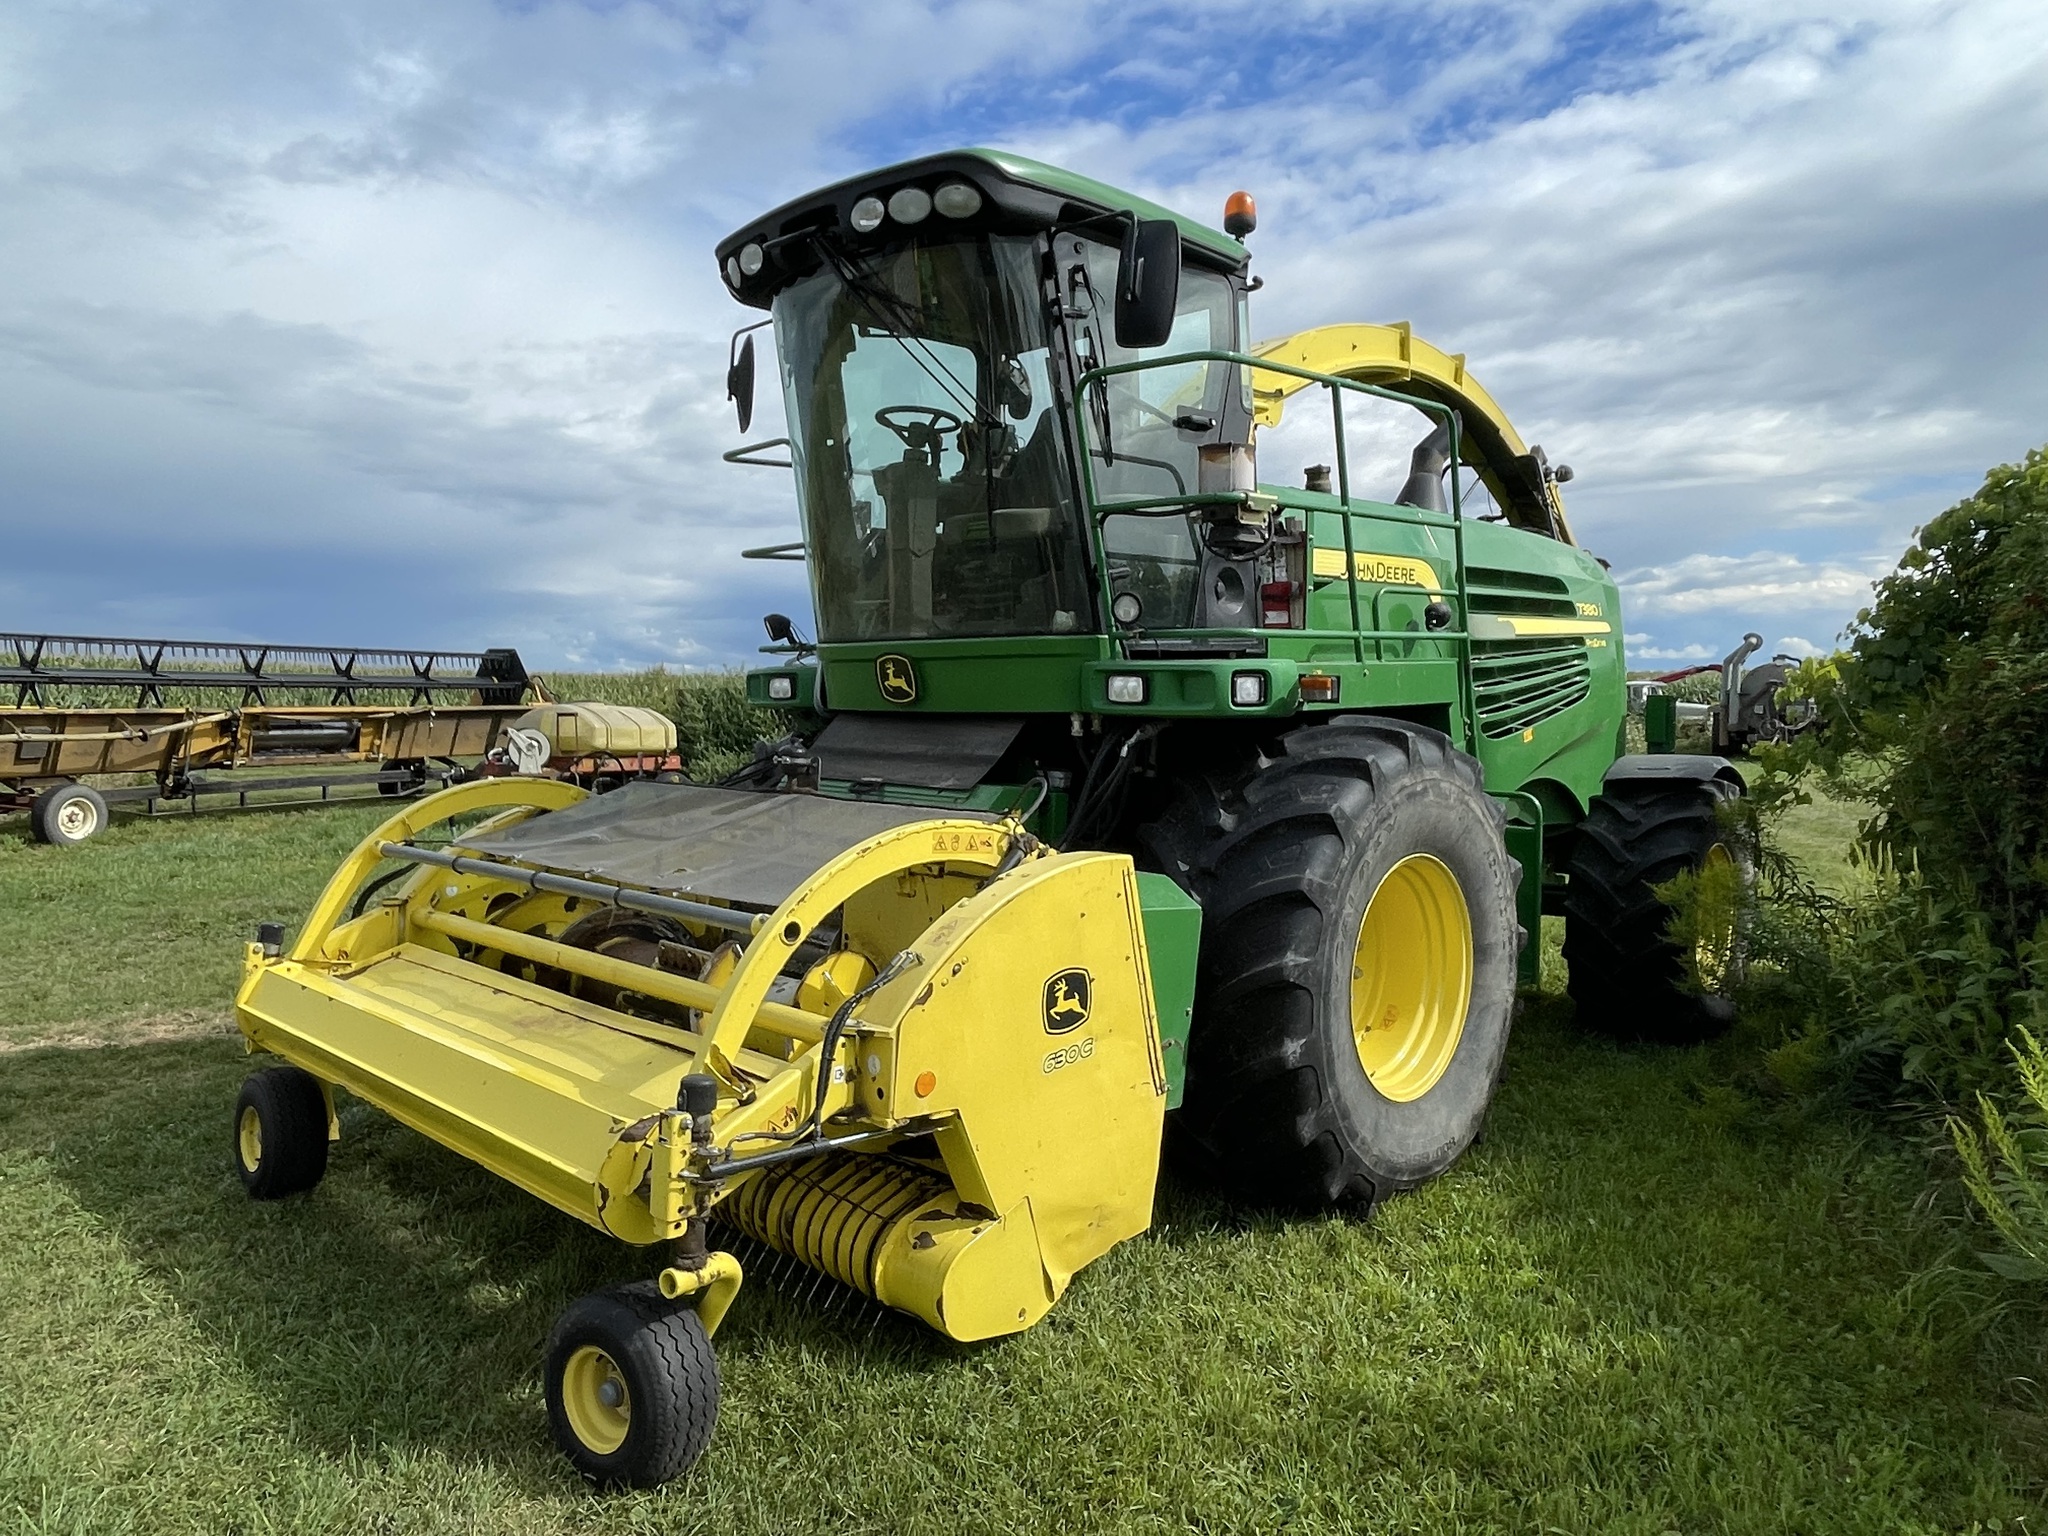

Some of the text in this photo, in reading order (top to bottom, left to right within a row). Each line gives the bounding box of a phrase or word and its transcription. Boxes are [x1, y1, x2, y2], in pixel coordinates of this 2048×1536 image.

[1341, 562, 1416, 582] HN DEERE
[1043, 1037, 1094, 1074] 630C
